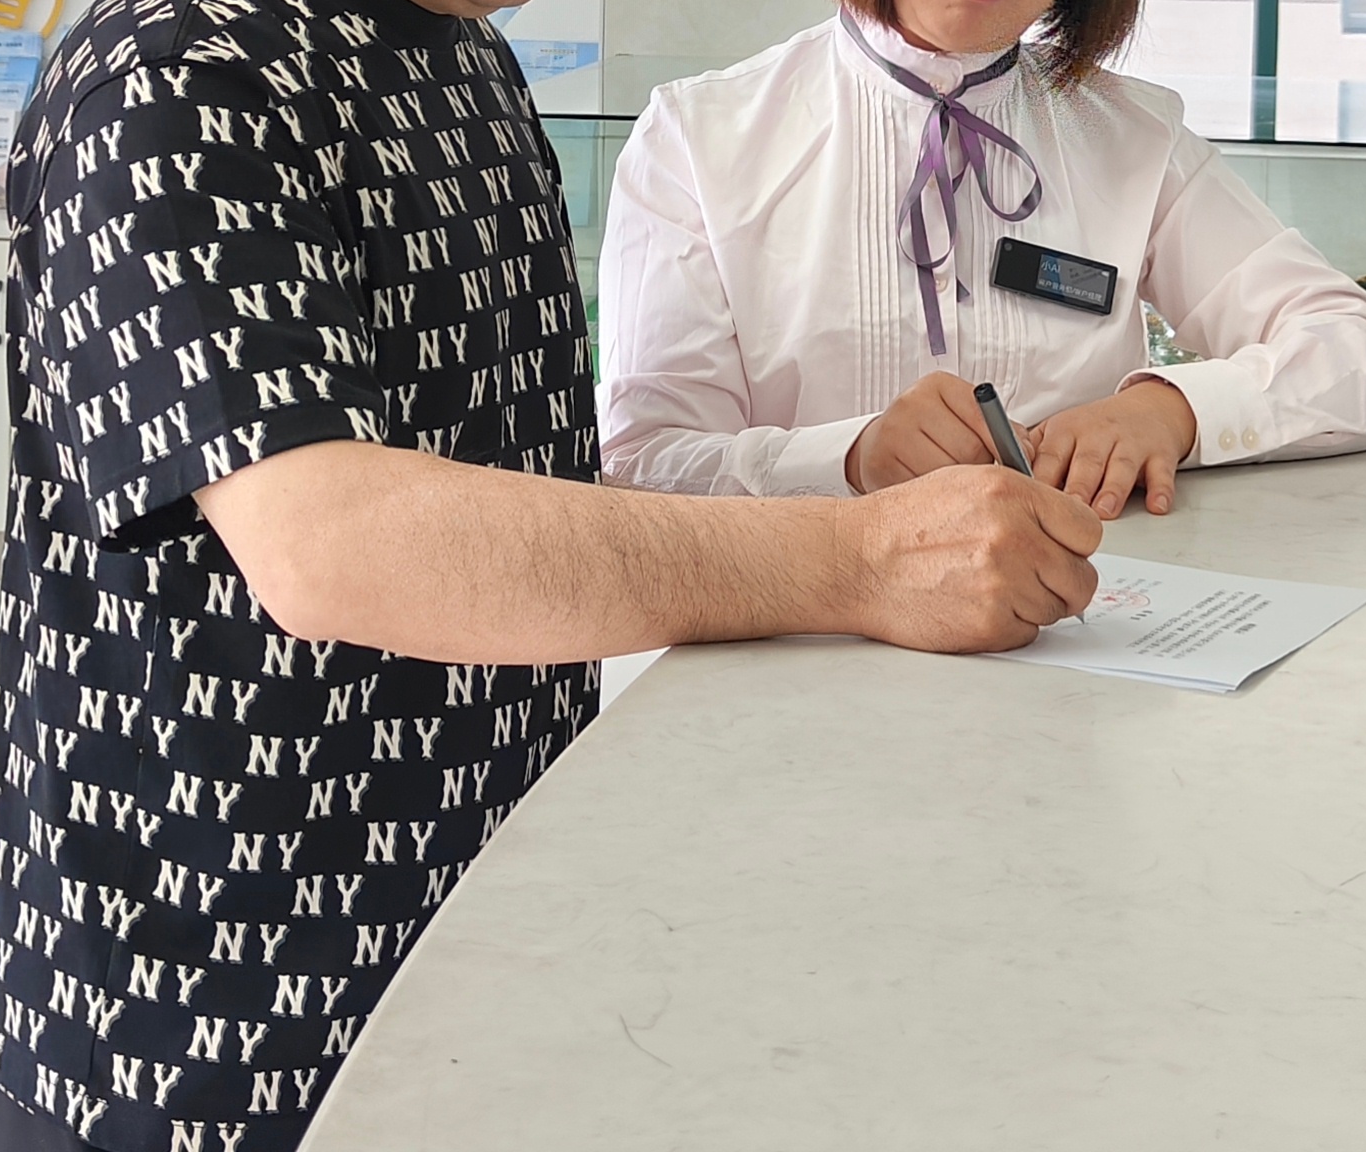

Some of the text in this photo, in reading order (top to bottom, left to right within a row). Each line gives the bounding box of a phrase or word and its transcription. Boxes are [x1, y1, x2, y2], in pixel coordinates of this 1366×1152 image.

[123, 66, 189, 109] NY
[260, 51, 314, 97] NY
[381, 91, 426, 129] NY
[443, 84, 479, 117] NY
[76, 120, 123, 181] NY
[197, 106, 267, 149] NY
[435, 128, 470, 165] NY
[129, 153, 201, 202] NY
[371, 137, 415, 175] NY
[428, 177, 466, 215] NY
[44, 193, 83, 256] NY
[87, 213, 134, 274] NY
[143, 243, 219, 294] NY
[404, 228, 449, 271] NY
[460, 267, 492, 310] NY
[502, 255, 530, 296] NY
[60, 286, 102, 350] NY
[229, 281, 306, 320] NY
[375, 284, 414, 327] NY
[538, 293, 570, 334] NY
[108, 305, 164, 369] NY
[174, 327, 242, 389] NY
[418, 324, 466, 369] NY
[253, 364, 330, 408] NY
[468, 365, 501, 408] NY
[511, 349, 543, 392] NY
[76, 381, 132, 445] NY
[138, 401, 192, 464] NY
[96, 476, 149, 536] NY
[43, 532, 99, 580] NY
[93, 590, 144, 640] NY
[36, 625, 90, 676] NY
[262, 634, 337, 679] NY
[182, 673, 258, 723] NY
[323, 674, 378, 724] NY
[446, 665, 497, 706] NY
[78, 686, 141, 736] NY
[493, 699, 531, 746] NY
[245, 735, 319, 775] NY
[371, 718, 441, 759] NY
[68, 781, 134, 831] NY
[166, 771, 241, 821] NY
[306, 773, 369, 819] NY
[441, 761, 490, 808] NY
[228, 832, 302, 870] NY
[365, 822, 435, 862] NY
[153, 859, 223, 913] NY
[291, 875, 362, 914] NY
[14, 901, 62, 959] NY
[209, 922, 287, 963] NY
[353, 920, 415, 965] NY
[127, 954, 204, 1004] NY
[270, 974, 351, 1018] NY
[4, 994, 46, 1053] NY
[186, 1016, 267, 1062] NY
[112, 1053, 181, 1108] NY
[249, 1069, 320, 1116] NY
[171, 1120, 245, 1152] NY
